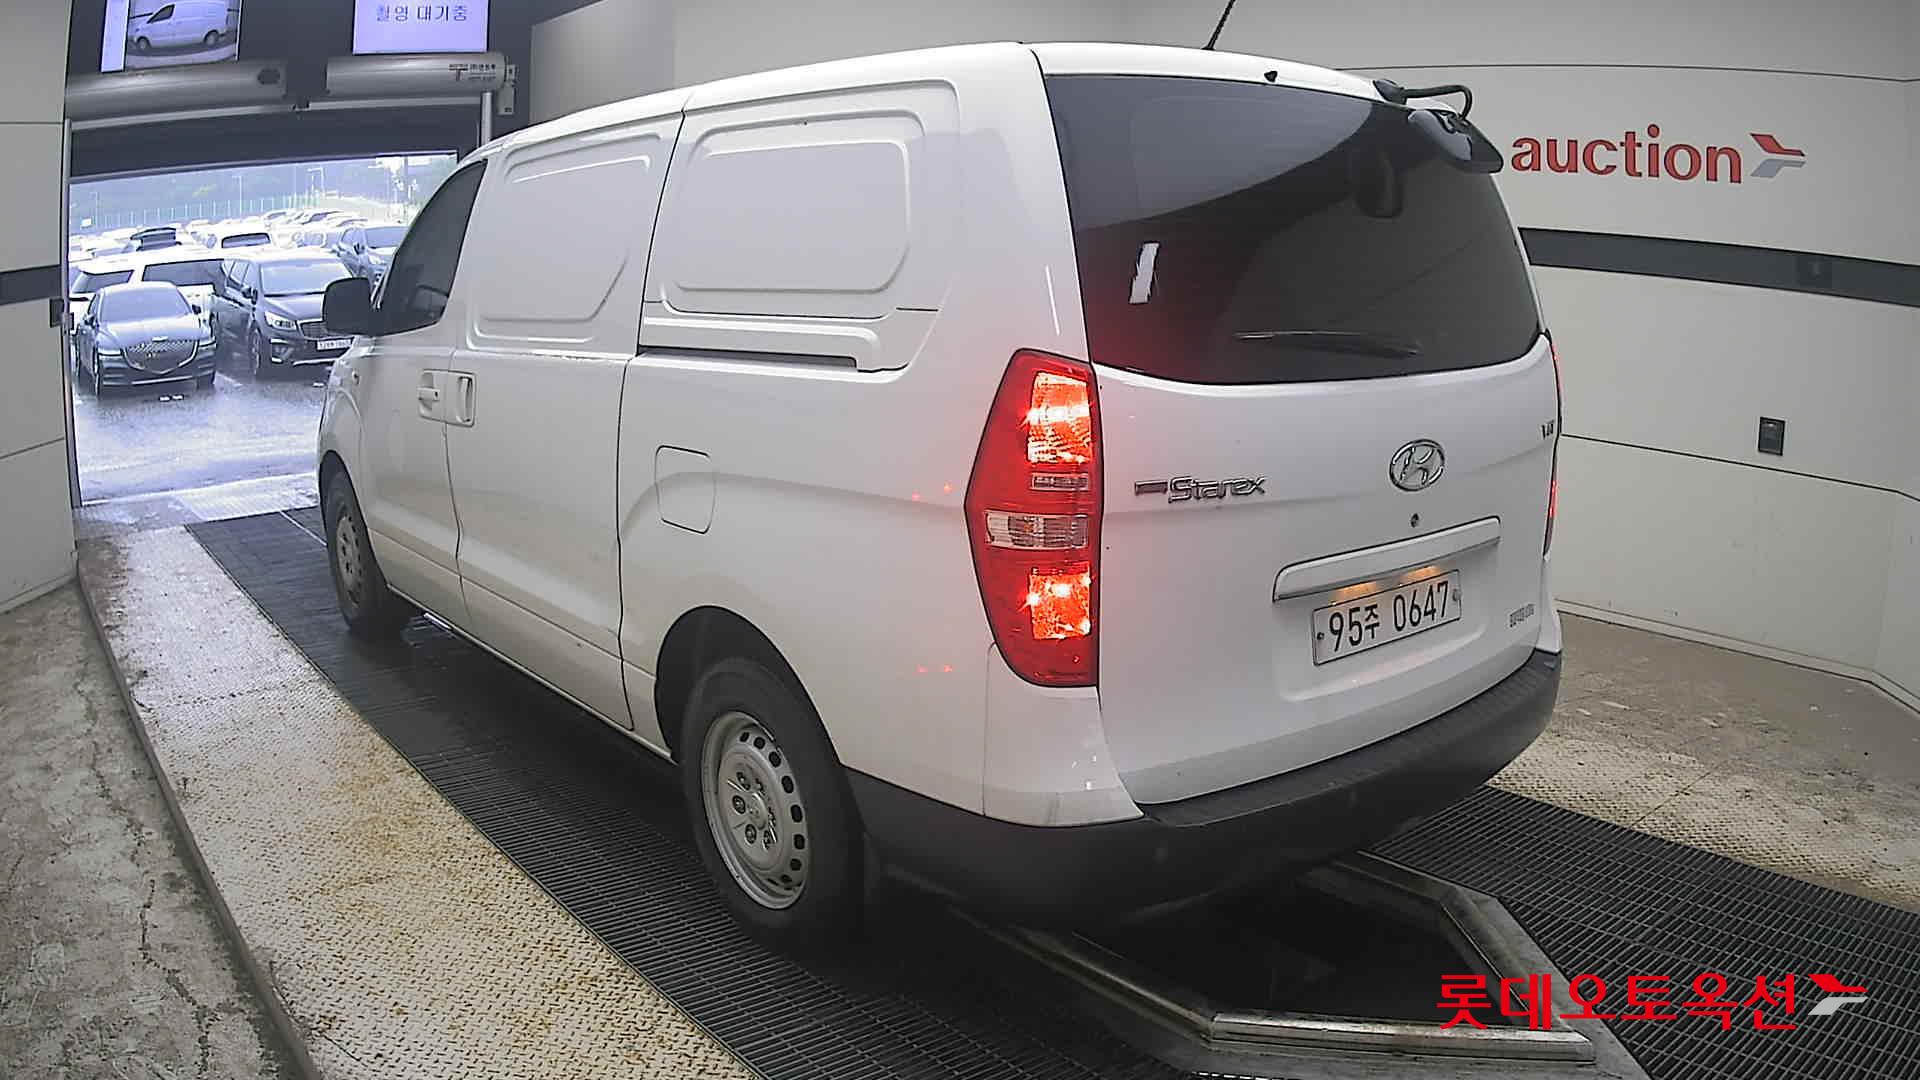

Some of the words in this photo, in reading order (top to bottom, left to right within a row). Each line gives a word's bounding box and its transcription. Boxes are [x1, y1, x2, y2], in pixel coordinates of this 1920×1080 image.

[1511, 123, 1742, 184] auction
[1167, 476, 1265, 503] Starex
[1329, 603, 1380, 653] 95주
[1392, 581, 1449, 632] 0647
